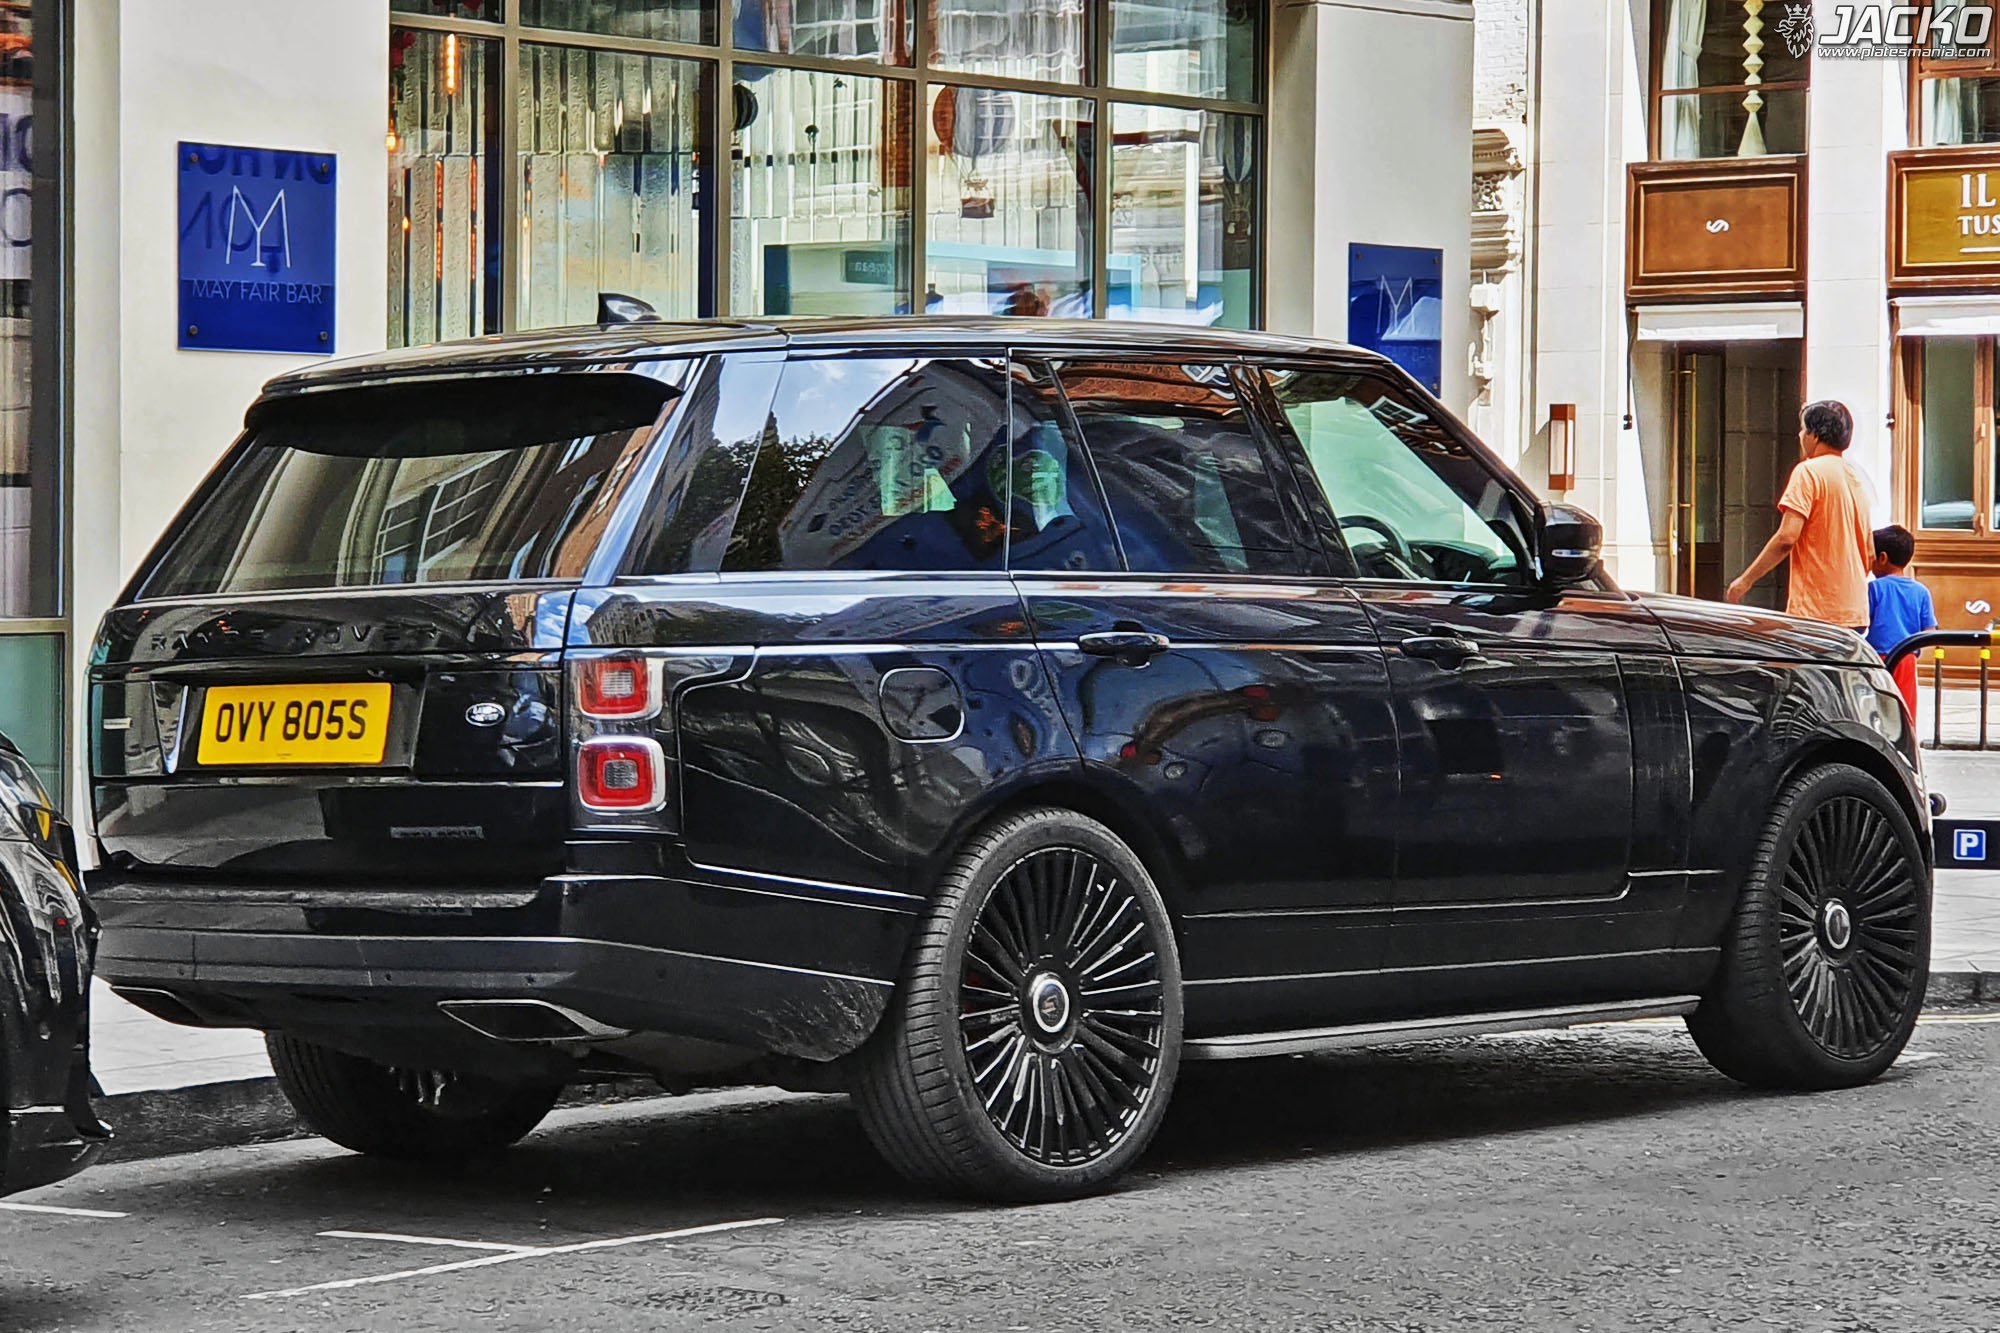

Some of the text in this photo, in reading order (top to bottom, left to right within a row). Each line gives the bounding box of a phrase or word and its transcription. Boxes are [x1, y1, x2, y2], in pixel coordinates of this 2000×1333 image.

[1961, 173, 1997, 208] IL
[192, 279, 323, 304] MAY FAIR BAR
[151, 628, 266, 650] RAN
[215, 699, 369, 743] OVY 805S
[1960, 832, 1979, 857] P
